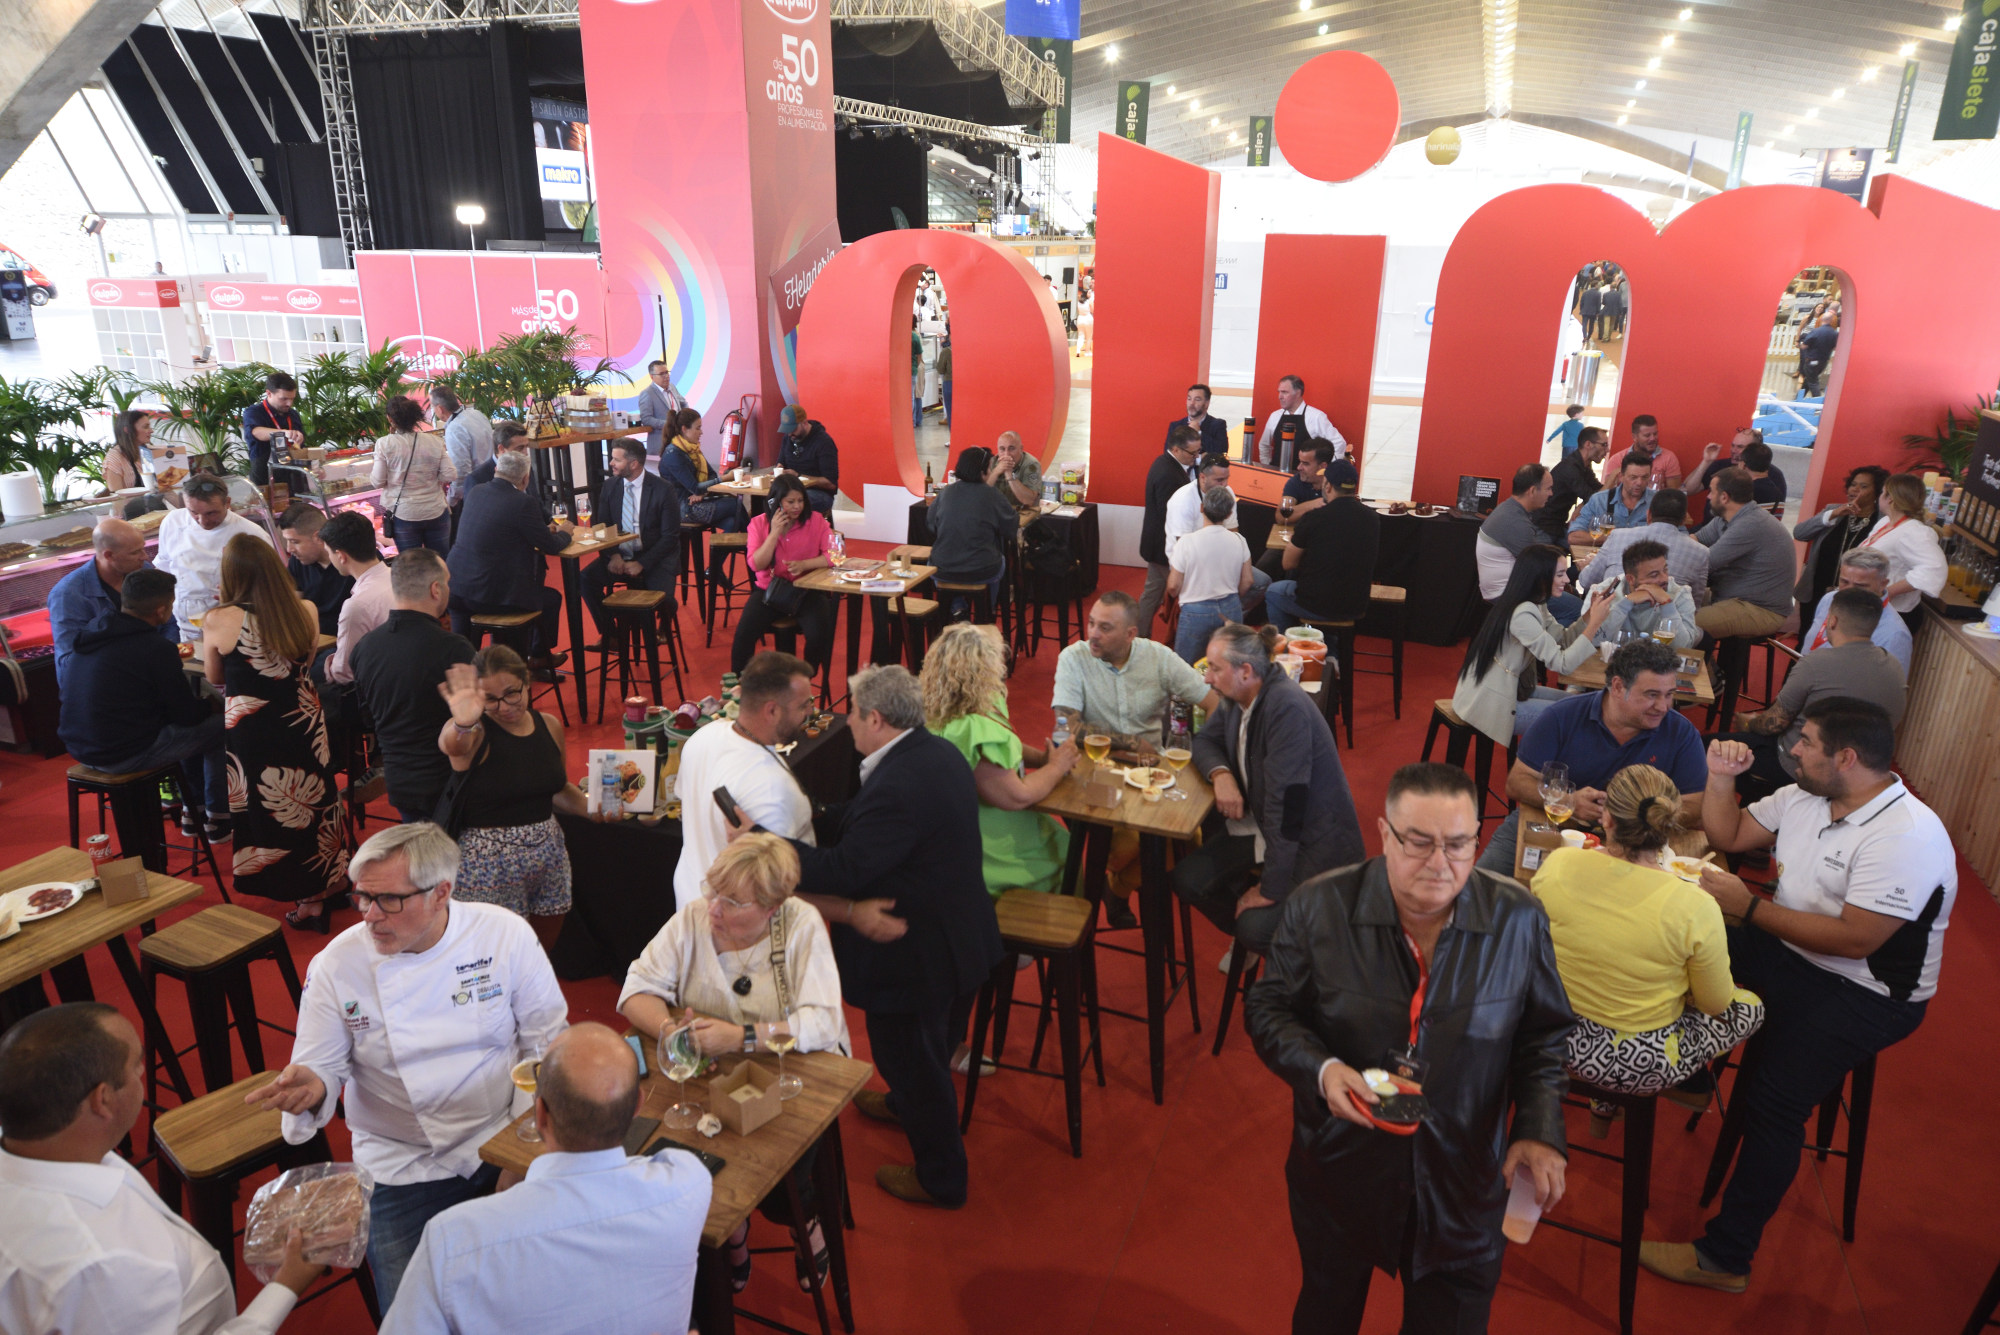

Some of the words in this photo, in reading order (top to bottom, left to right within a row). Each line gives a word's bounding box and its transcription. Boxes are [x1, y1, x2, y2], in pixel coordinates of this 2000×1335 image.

[782, 33, 819, 87] 50
[1961, 18, 1998, 119] cajasiete
[766, 73, 803, 105] años
[544, 166, 579, 183] makro
[214, 290, 241, 304] dulpán
[291, 293, 318, 307] dulpán
[538, 289, 579, 321] 50
[1894, 886, 1905, 895] 50
